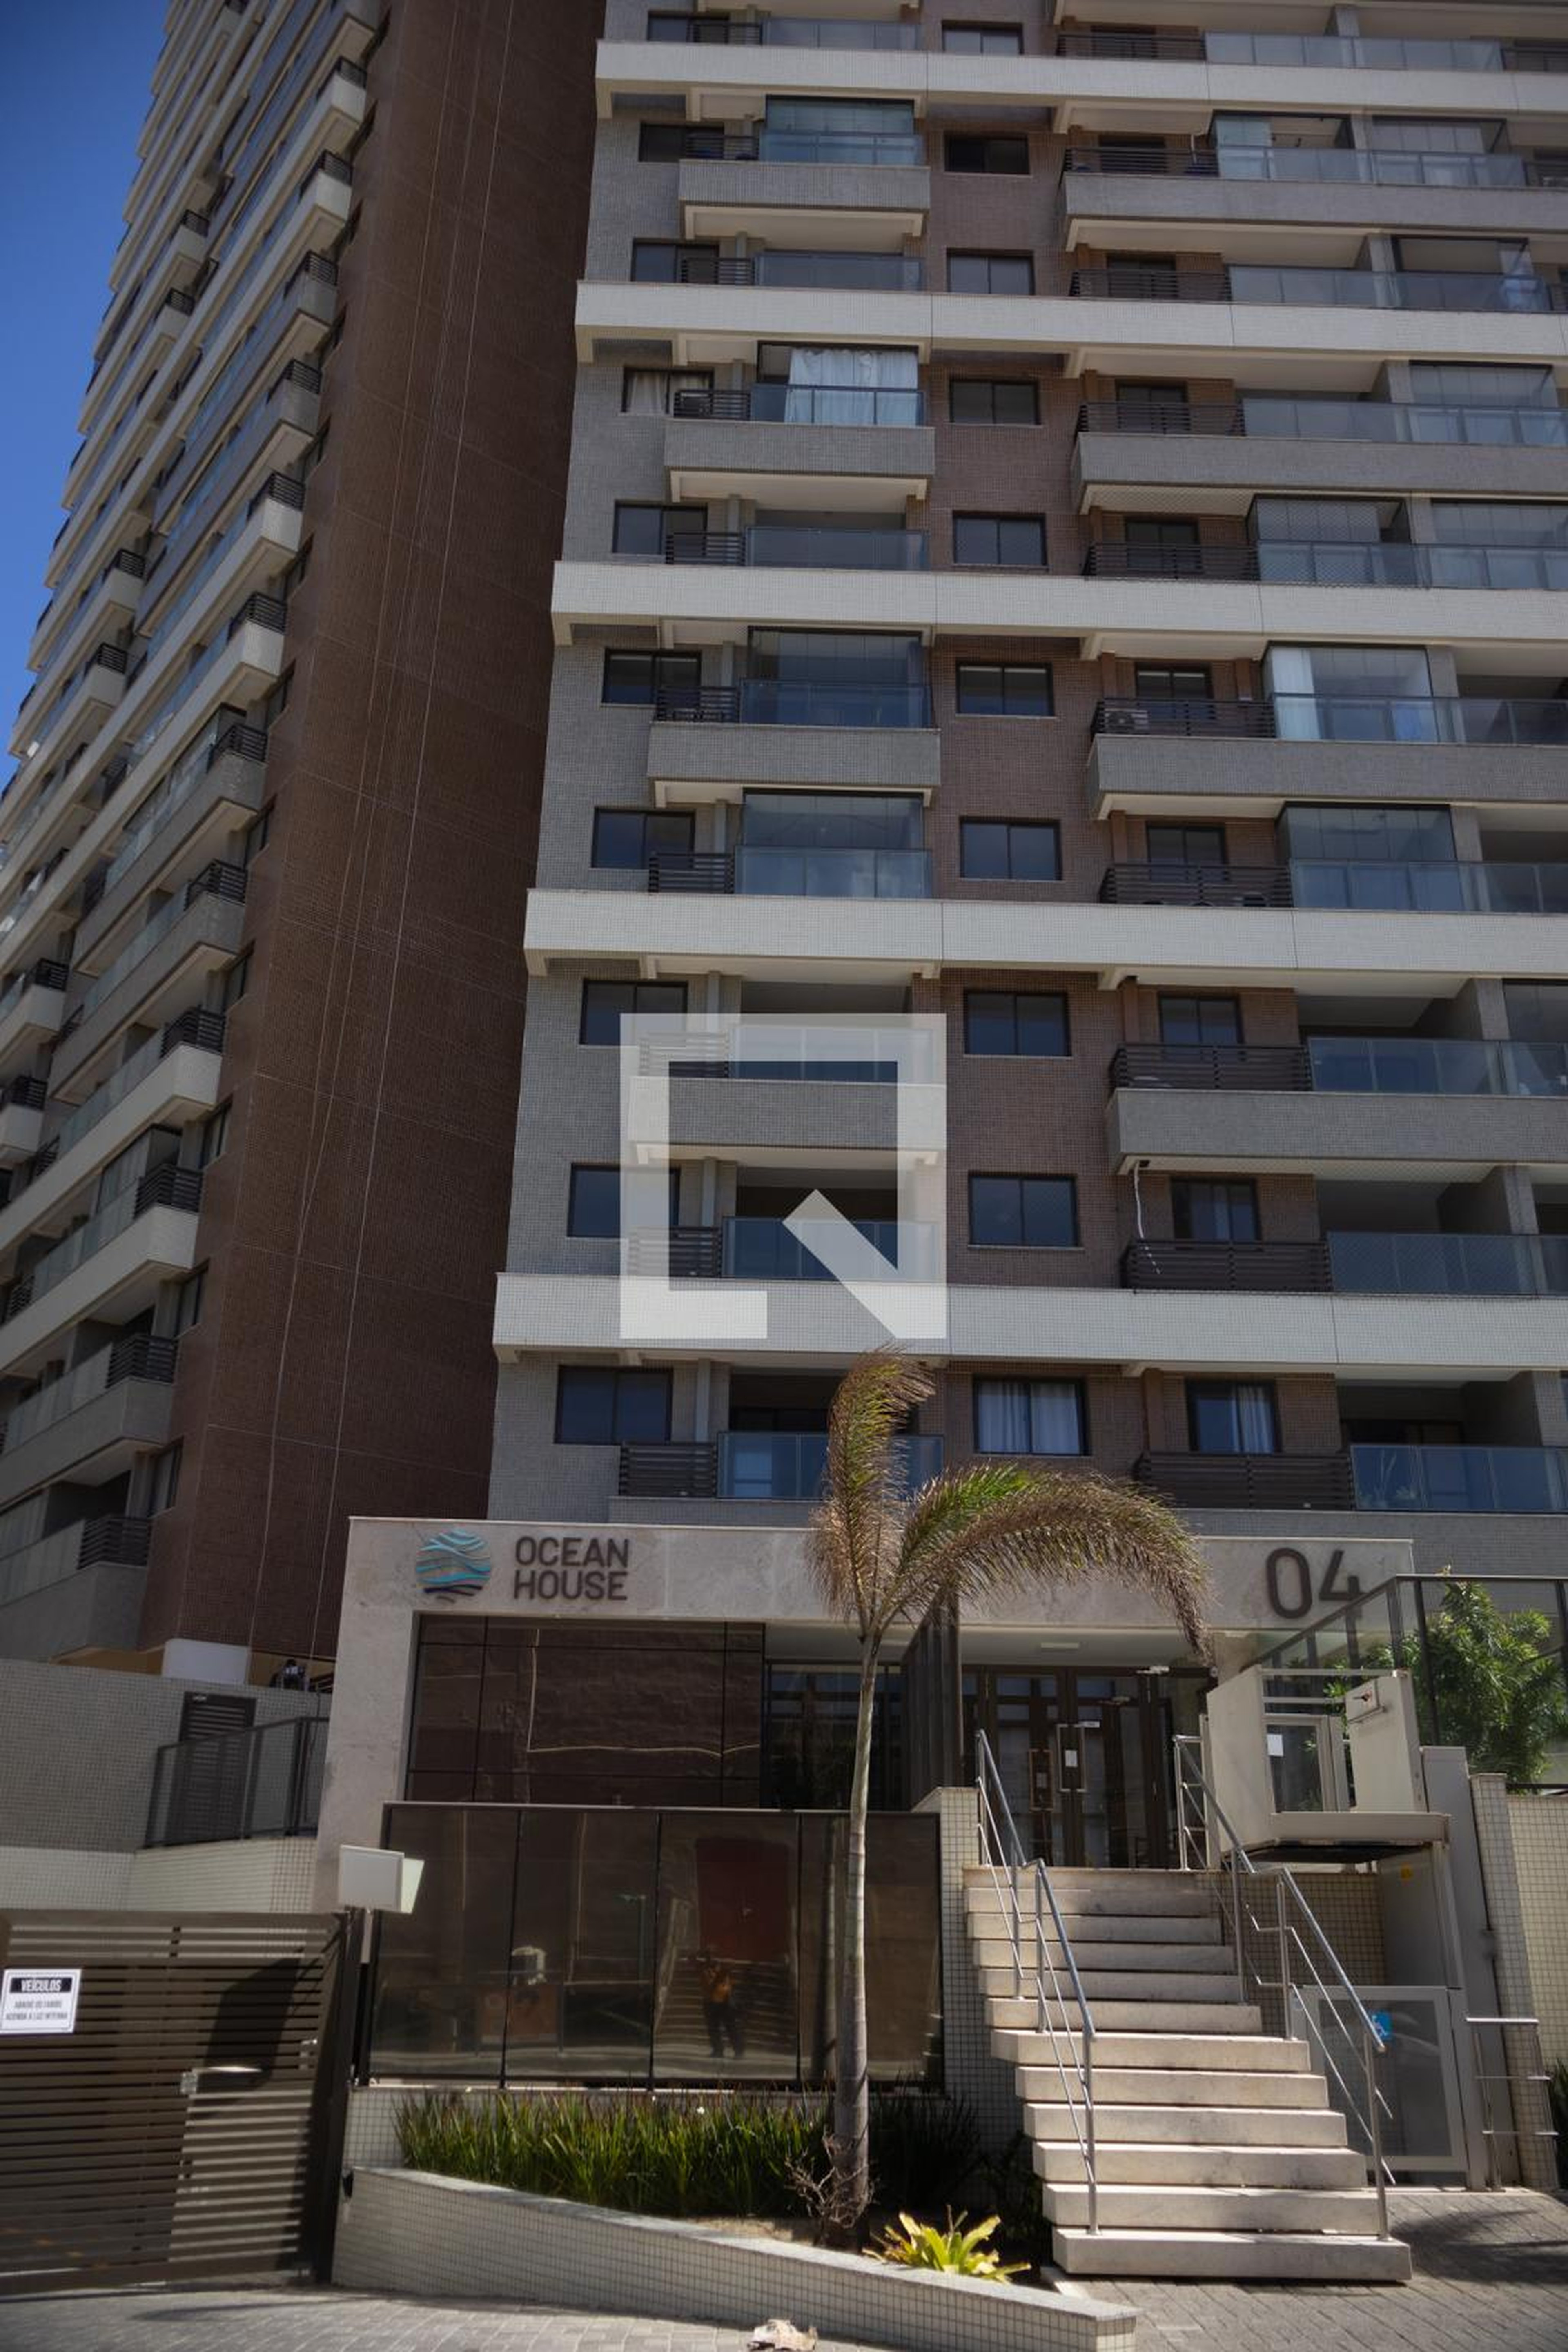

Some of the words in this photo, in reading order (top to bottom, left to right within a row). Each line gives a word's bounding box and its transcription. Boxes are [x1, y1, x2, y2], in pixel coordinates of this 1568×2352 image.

[515, 1536, 629, 1568] OCEAN
[514, 1570, 628, 1600] HOUSE
[1266, 1547, 1370, 1619] 04
